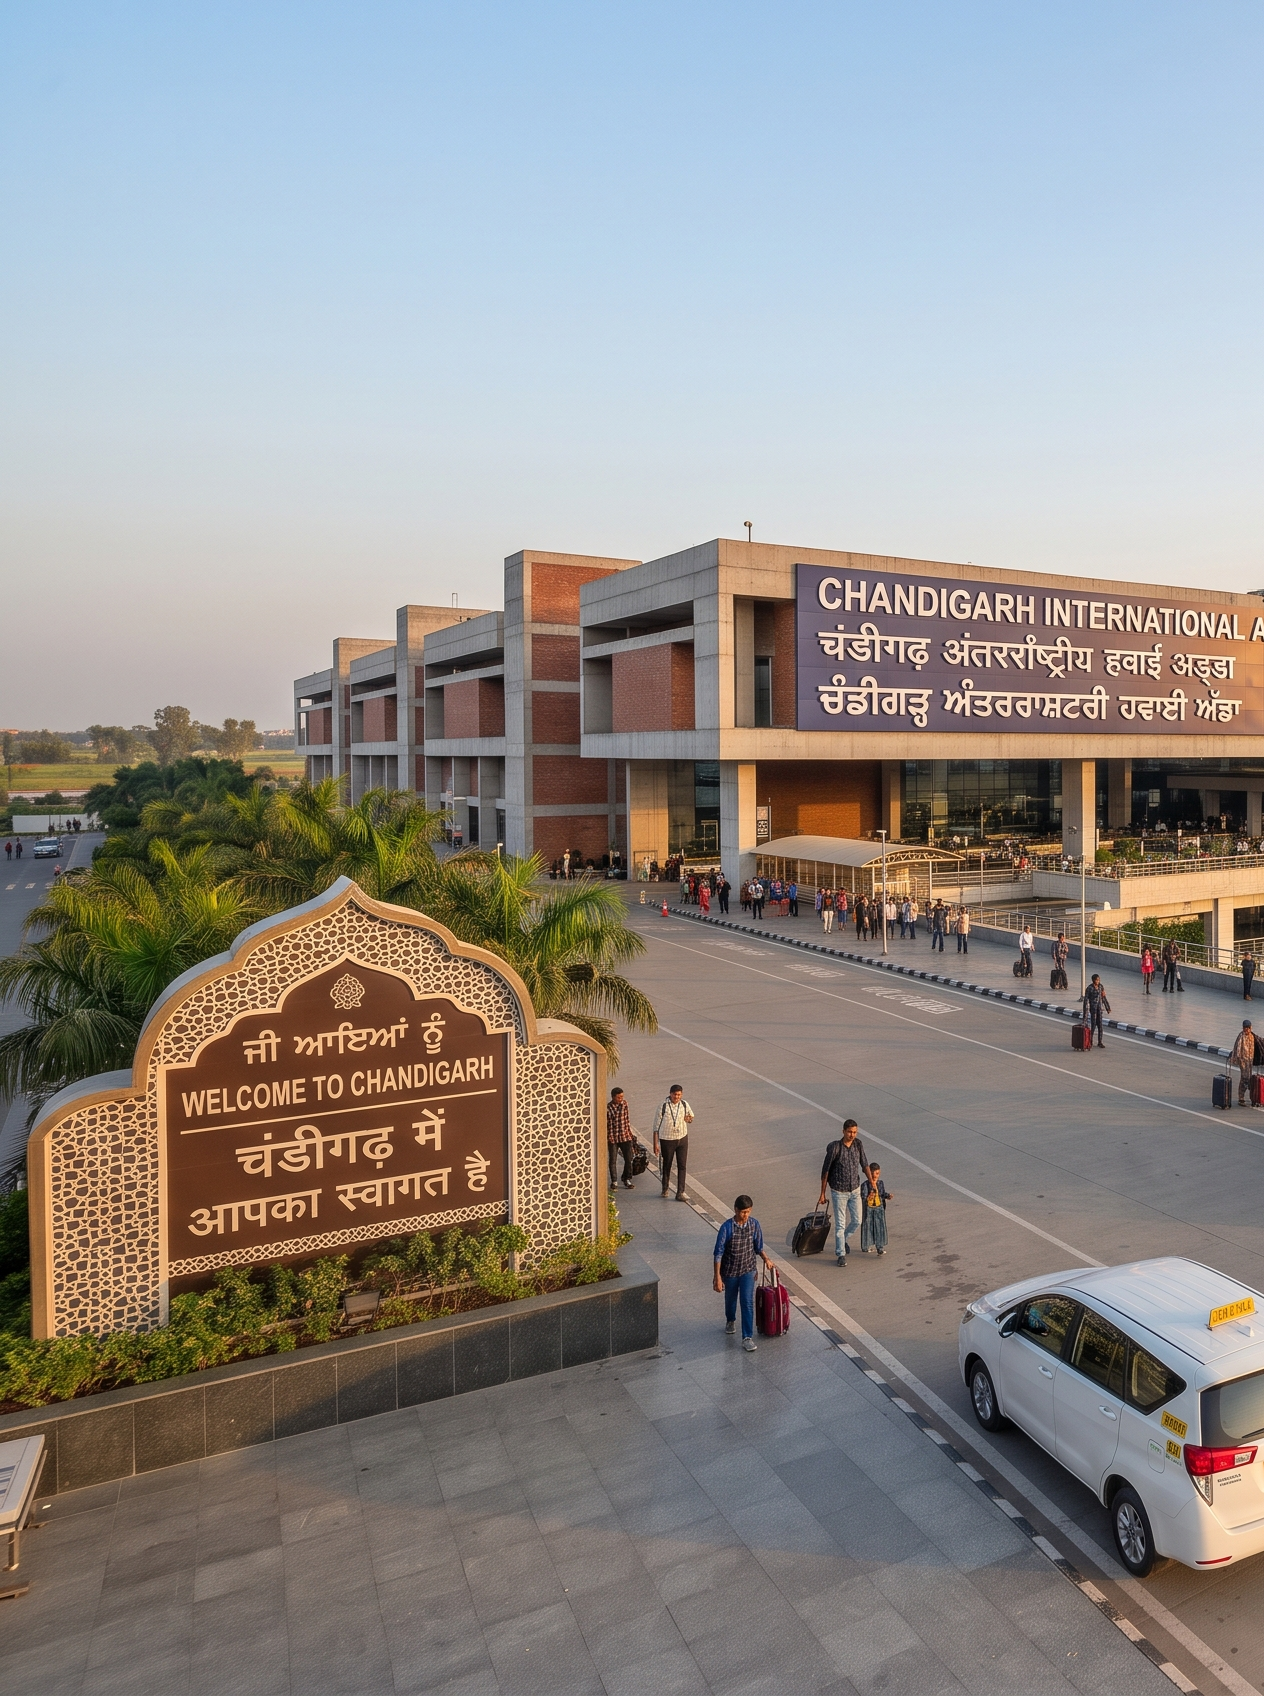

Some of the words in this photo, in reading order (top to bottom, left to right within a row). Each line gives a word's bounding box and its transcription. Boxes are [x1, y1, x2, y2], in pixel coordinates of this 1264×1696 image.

[818, 576, 1035, 625] CHANDIGARH
[1043, 597, 1246, 641] INTERNATIONAL
[818, 622, 932, 671] चंडीगढ़
[1103, 643, 1163, 681] हवाई
[942, 678, 1110, 720] ਅੰਤਰਰਾਸ਼ਟਰੀ
[1118, 688, 1189, 721] ਹਵਾਈ
[242, 1029, 282, 1065] ਜੀ
[293, 1016, 409, 1056] ਆਇਆਂ
[421, 1012, 446, 1055] ਨੂੰ
[181, 1078, 307, 1118] WELCOME
[312, 1073, 344, 1101] TO
[350, 1055, 495, 1097] CHANDIGARH
[235, 1124, 394, 1178] चंडीगढ़
[411, 1107, 446, 1151] में
[187, 1188, 322, 1237] आपका
[336, 1166, 452, 1212] स्वागत
[464, 1150, 491, 1192] है
